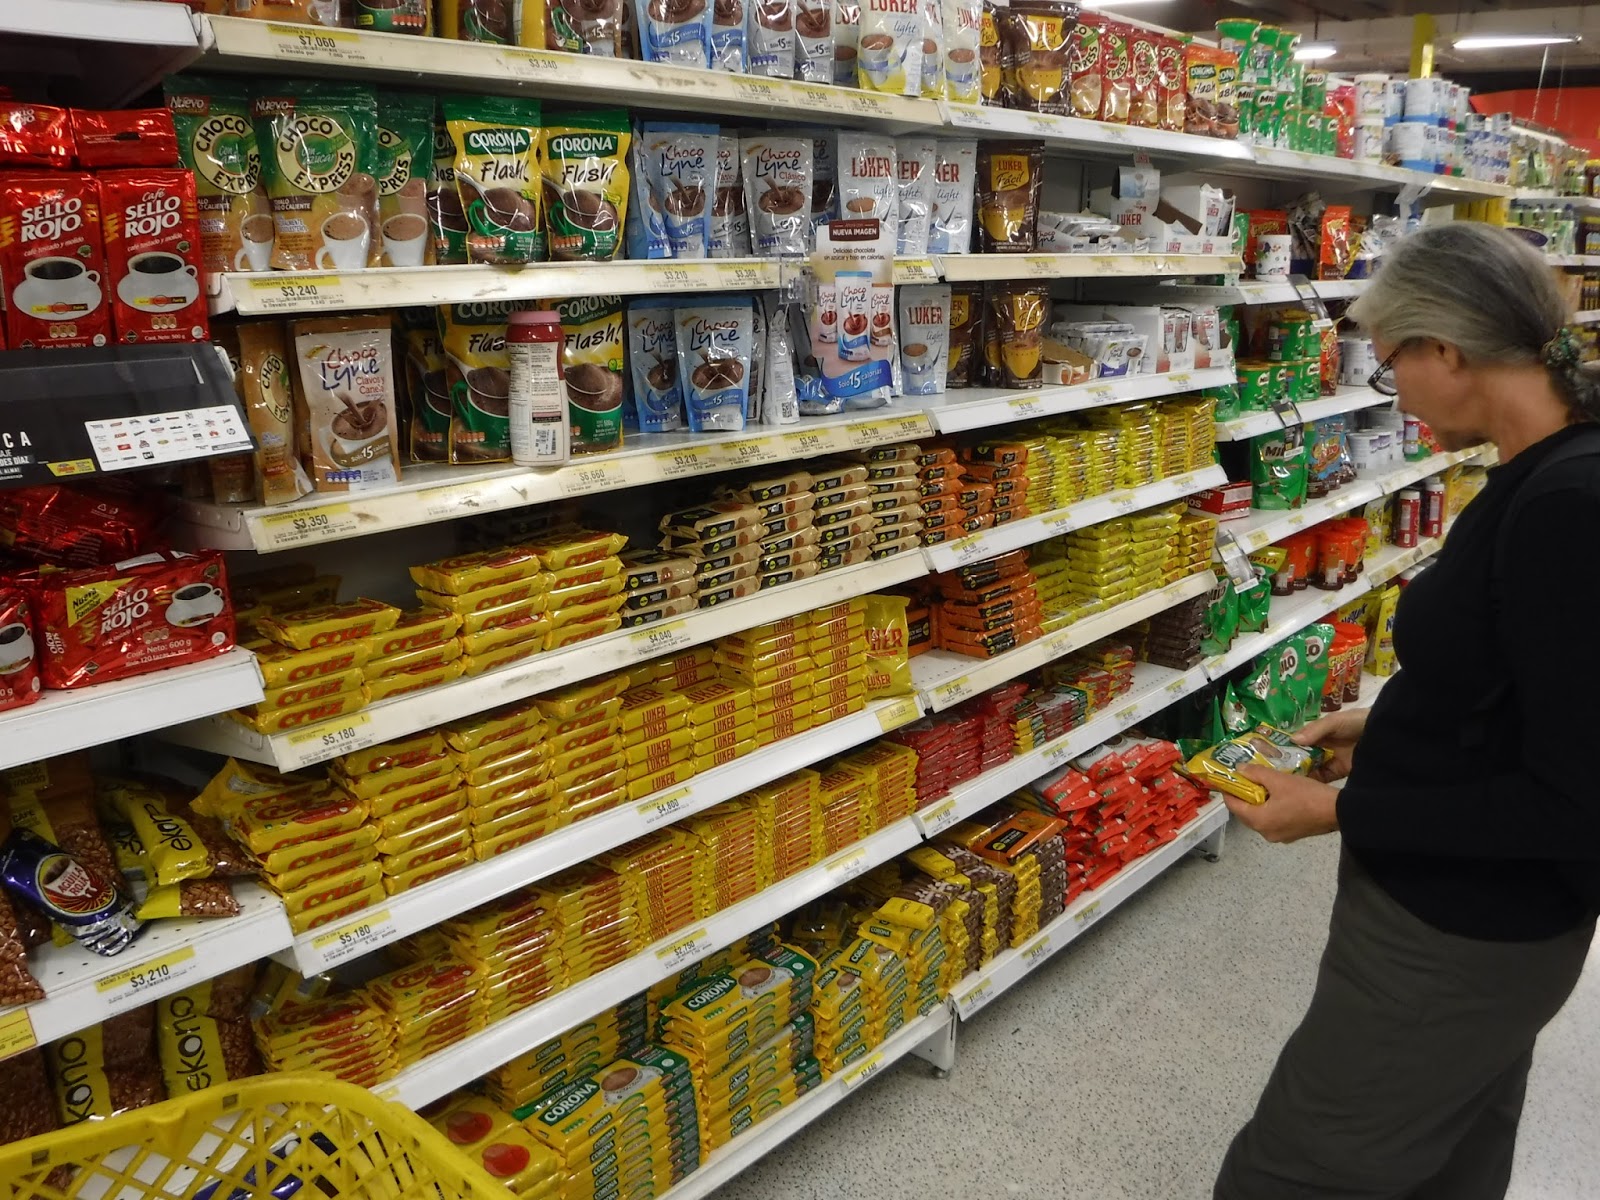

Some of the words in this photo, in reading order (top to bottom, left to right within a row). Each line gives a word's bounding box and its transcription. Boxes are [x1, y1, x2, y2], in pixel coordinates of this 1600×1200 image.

[299, 36, 336, 48] $7,060
[670, 31, 680, 43] 15
[529, 59, 557, 69] $3,340
[170, 96, 204, 109] Nuevo
[255, 100, 289, 111] Nuevo
[196, 117, 245, 151] CHOCO
[280, 118, 332, 152] CHOCO
[469, 131, 527, 149] CORONA
[552, 136, 613, 153] CORONA
[666, 146, 704, 162] Choco
[761, 148, 801, 163] Choco
[212, 153, 260, 190] EXPRESS
[294, 152, 353, 190] EXPRESS
[480, 159, 529, 183] Flash!
[661, 153, 705, 177] Lyne
[756, 158, 802, 178] Lyne
[852, 157, 892, 178] LUKER
[998, 161, 1023, 171] LUKER
[779, 171, 806, 182] Clásico
[142, 189, 165, 202] Café
[937, 189, 961, 204] light
[21, 198, 81, 224] SELLO
[125, 196, 181, 221] SELLO
[21, 214, 83, 243] ROJO
[125, 211, 182, 240] ROJO
[665, 270, 689, 280] $3,210
[281, 286, 318, 296] $3,240
[844, 286, 866, 298] Choco
[556, 295, 623, 319] CORONA
[841, 293, 867, 308] Lyne
[909, 306, 943, 325] LUKER
[564, 323, 623, 350] Flash!
[696, 320, 739, 335] Choco
[690, 327, 740, 351] Lyne
[327, 347, 377, 369] Choco
[320, 357, 380, 391] Lyne
[838, 378, 850, 389] Solo
[849, 371, 861, 388] 15
[713, 395, 722, 405] 15
[799, 435, 818, 446] $3,540
[861, 428, 878, 437] $4,780
[361, 447, 373, 459] 15
[739, 445, 759, 456] $3,380
[1265, 446, 1285, 456] MIL
[674, 454, 697, 466] $3,210
[579, 469, 604, 481] $6,660
[293, 514, 327, 529] $3,350
[102, 588, 148, 620] SELLO
[101, 602, 149, 635] ROJO
[649, 630, 671, 643] $4,040
[126, 648, 145, 659] Cont.
[147, 644, 167, 655] Neto:
[169, 639, 184, 649] 600
[776, 662, 797, 679] LUKER
[867, 674, 891, 687] LUKER
[642, 704, 666, 722] LUKER
[713, 700, 736, 718] LUKER
[773, 709, 794, 726] LUKER
[713, 716, 736, 734] LUKER
[773, 724, 795, 741] LUKER
[323, 726, 356, 745] $5,180
[713, 732, 736, 749] LUKER
[646, 738, 672, 757] LUKER
[713, 747, 736, 765] LUKER
[651, 772, 676, 790] LUKER
[657, 798, 679, 814] $4,800
[70, 876, 90, 897] ROJA
[339, 924, 371, 945] $5,180
[870, 927, 890, 936] CORONA
[674, 940, 695, 956] $2,750
[851, 940, 872, 962] CORON
[131, 963, 169, 988] $3,210
[688, 977, 735, 1009] CORONA
[170, 995, 212, 1092] ekono
[58, 1037, 96, 1124] kono
[545, 1083, 598, 1123] CORONA
